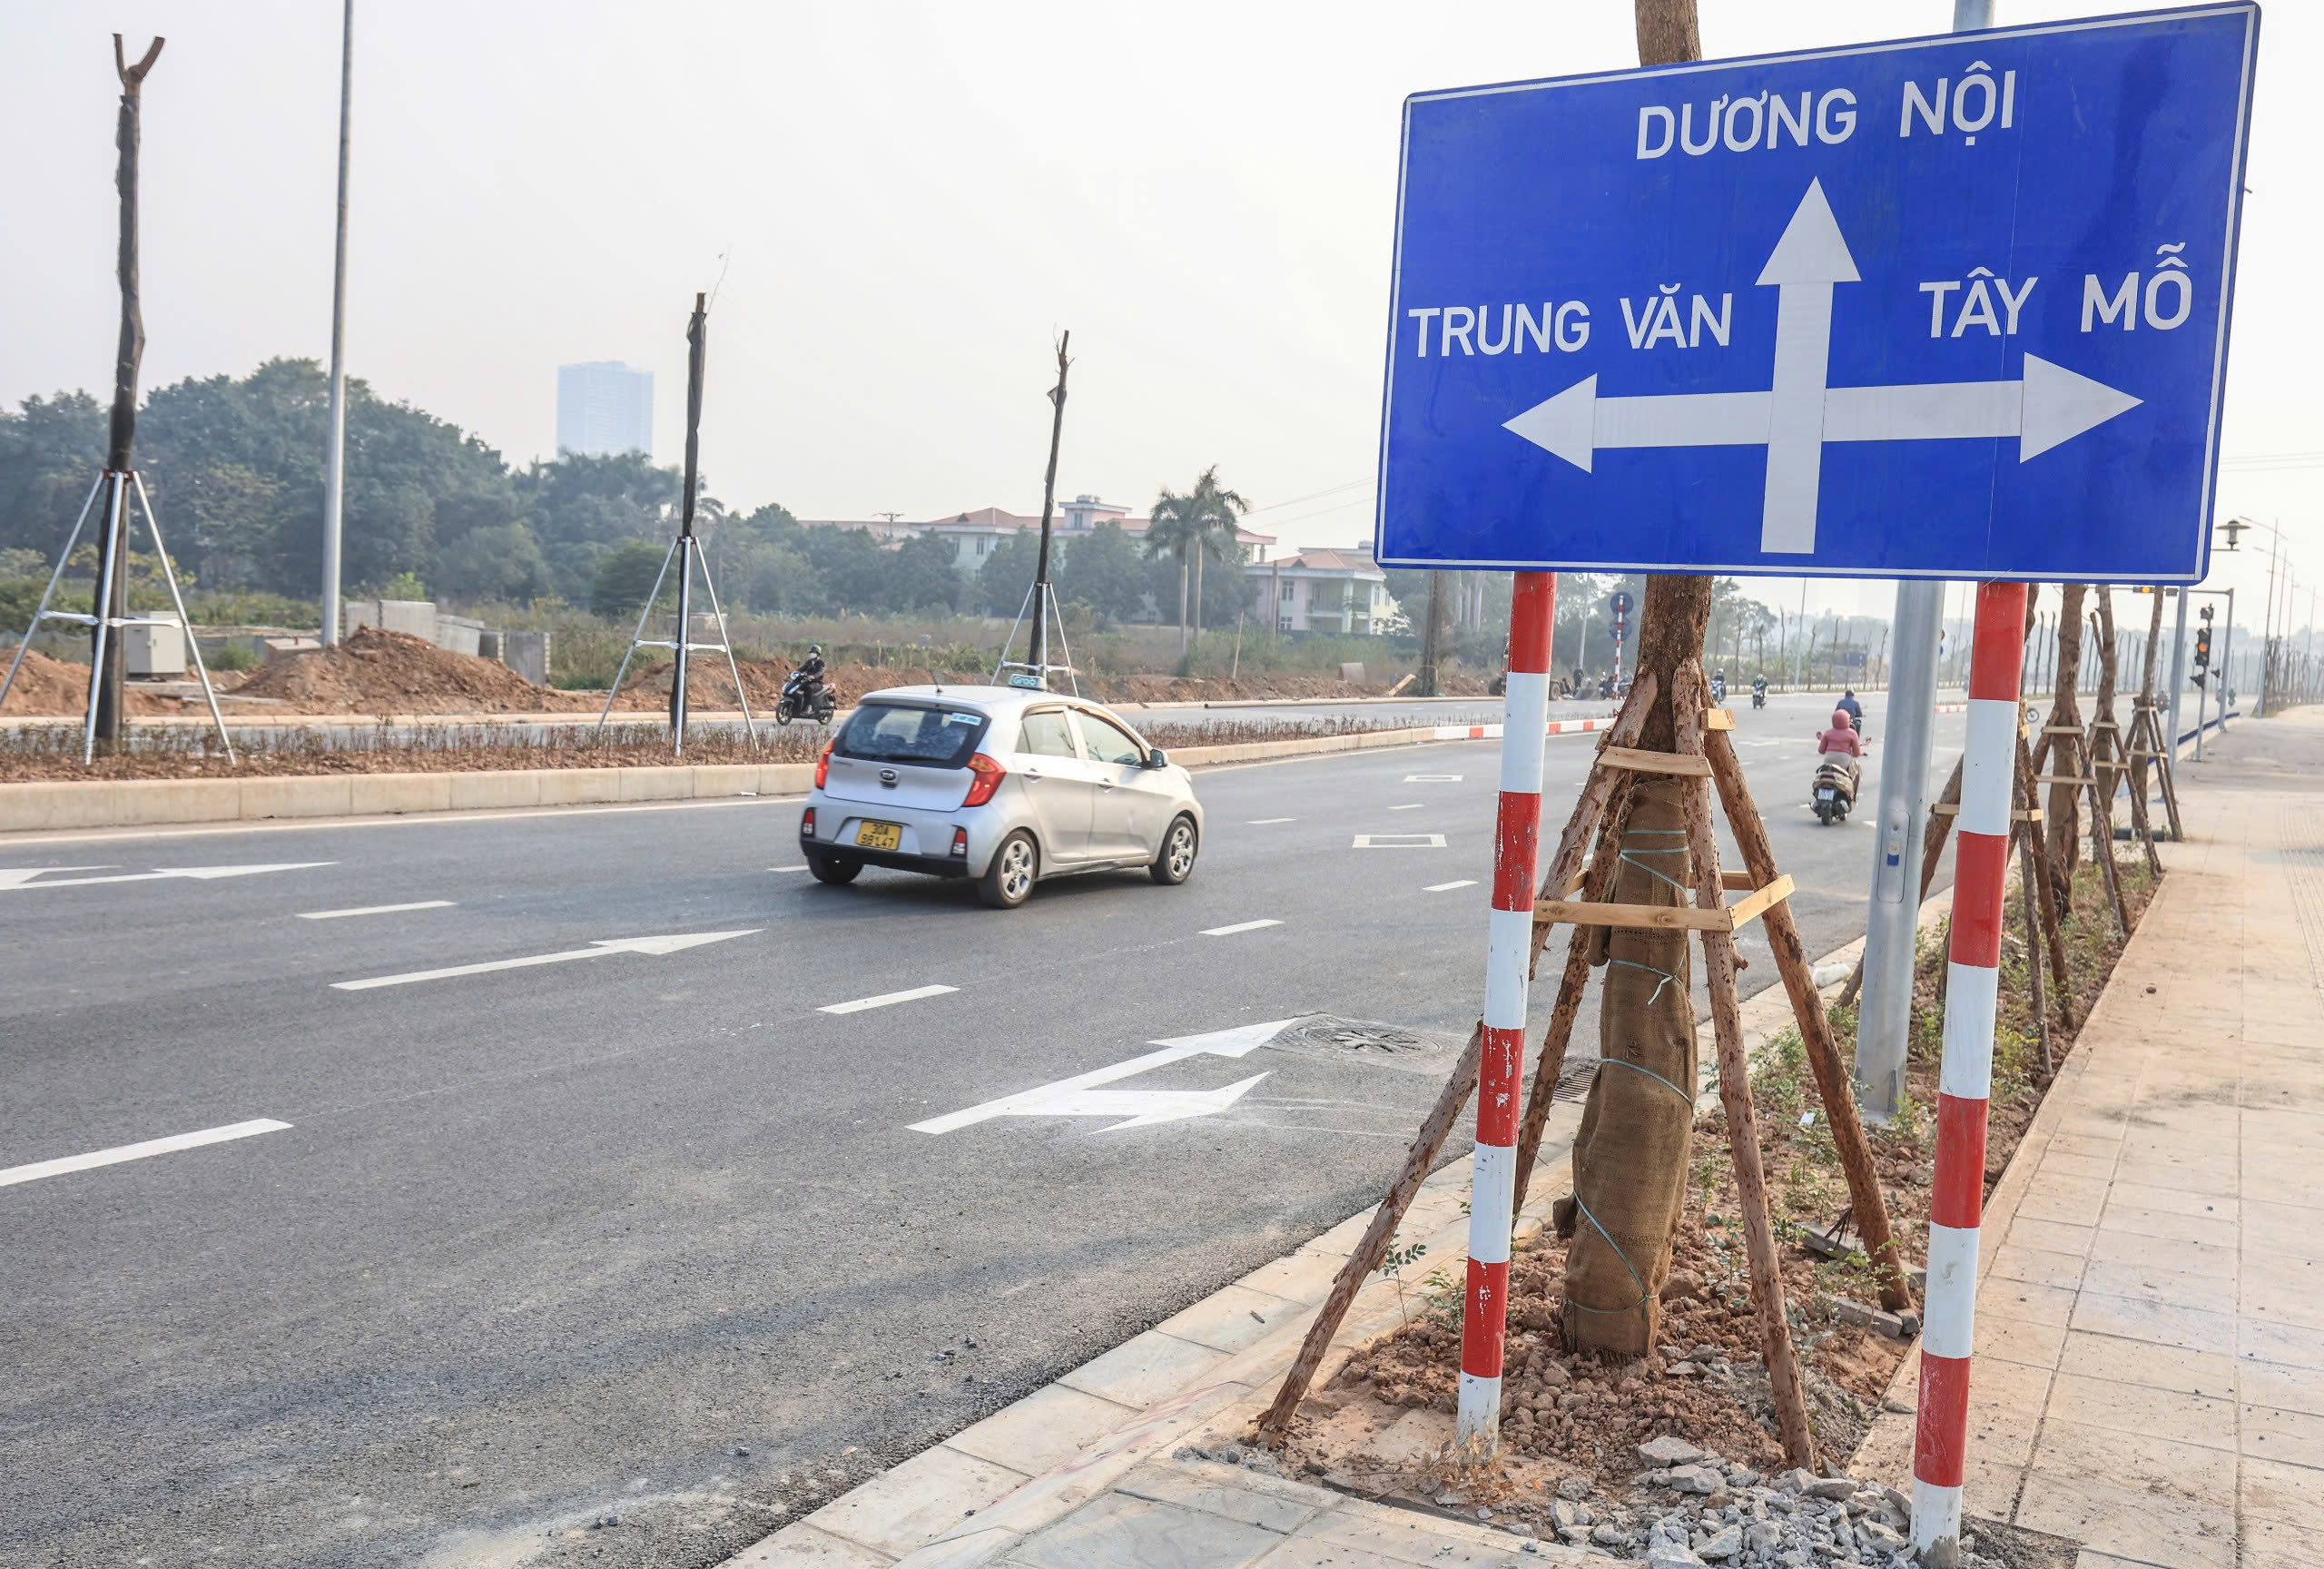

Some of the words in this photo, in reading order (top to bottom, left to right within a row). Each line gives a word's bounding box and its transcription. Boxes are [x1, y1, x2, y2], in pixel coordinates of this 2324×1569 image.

[1636, 88, 1857, 160] DƯƠNG
[1899, 60, 2016, 146] NỘI
[1408, 300, 1590, 358] TRUNG
[1619, 282, 1733, 350] VĂN
[1918, 266, 2039, 339] TÂY
[2080, 242, 2192, 332] MỖ
[1012, 676, 1037, 686] Grab
